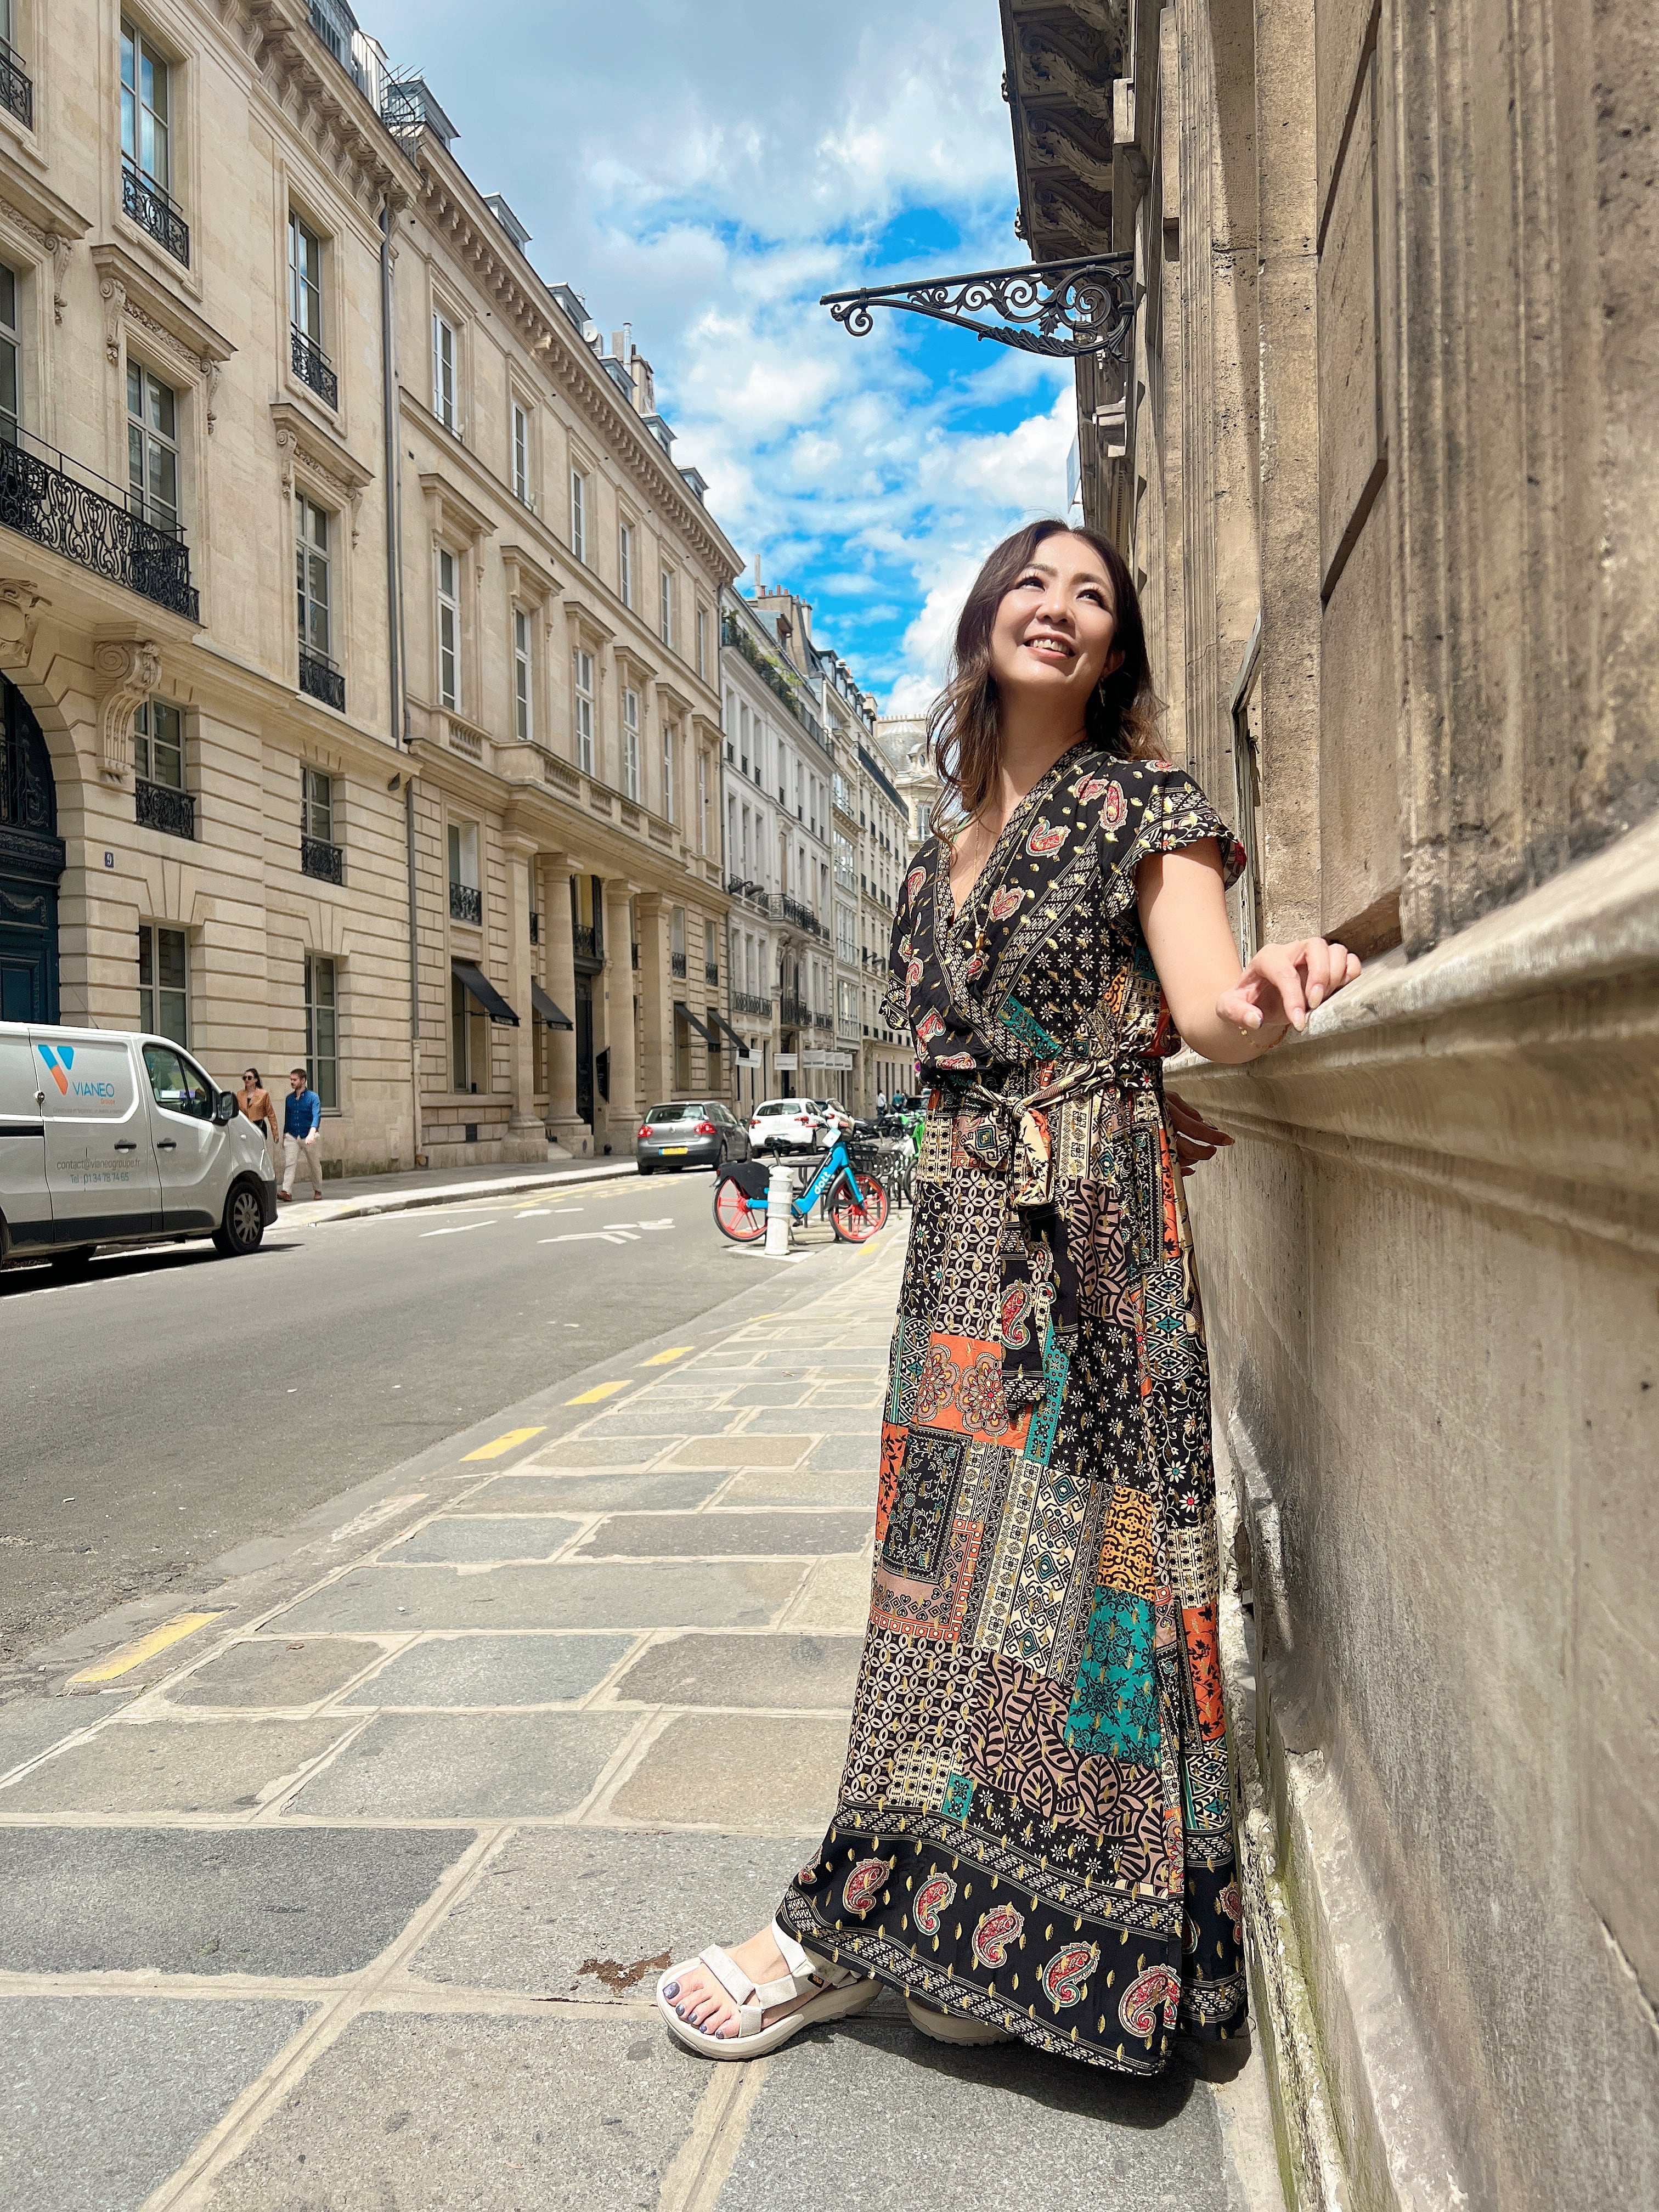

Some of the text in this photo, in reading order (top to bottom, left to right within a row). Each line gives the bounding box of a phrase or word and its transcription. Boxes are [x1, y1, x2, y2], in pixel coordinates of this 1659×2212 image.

[106, 854, 112, 866] 9
[72, 1081, 115, 1097] VIANEO
[57, 1158, 140, 1170] contact@vianeogroupe.fr
[814, 1171, 831, 1194] dott
